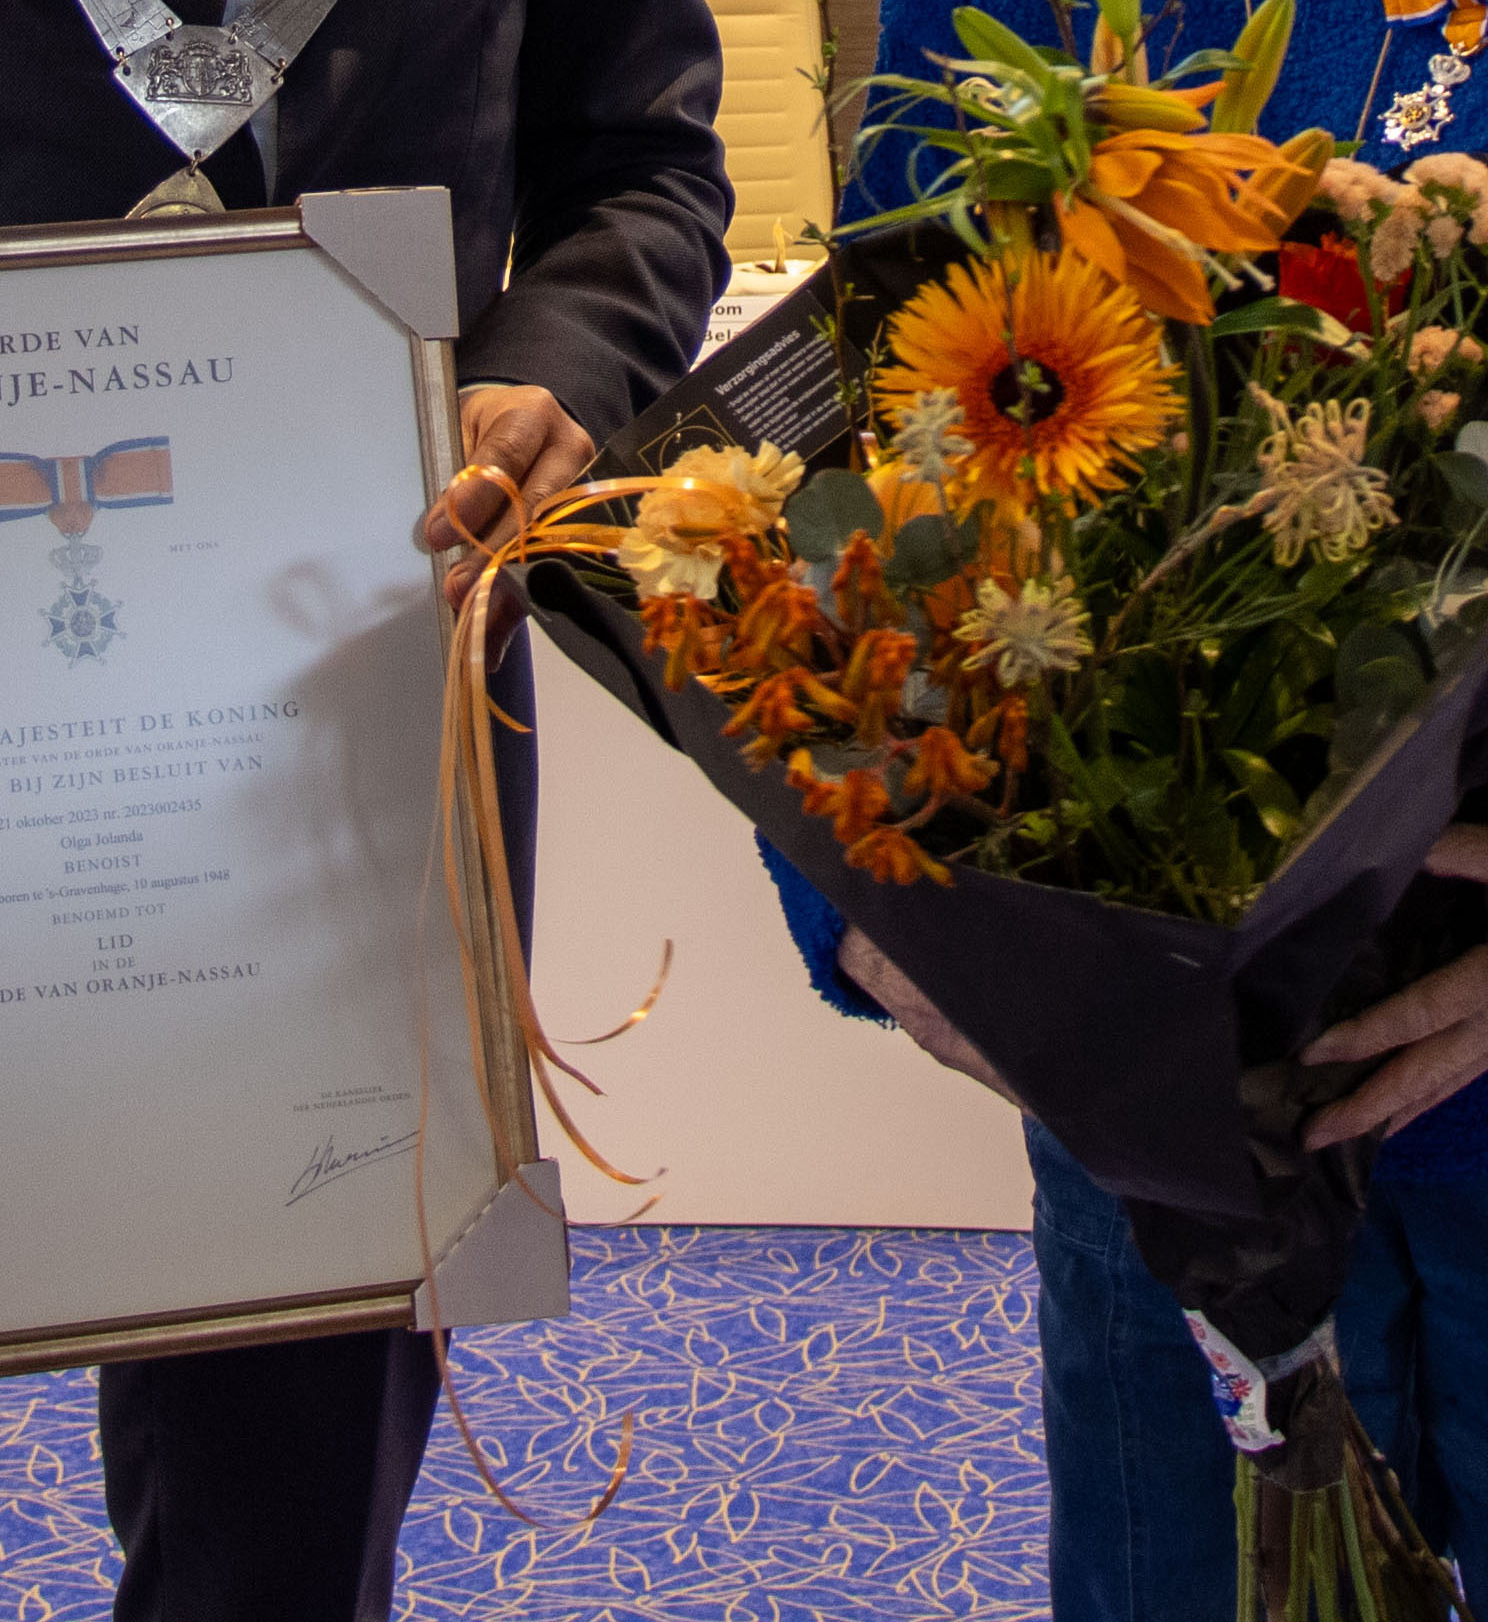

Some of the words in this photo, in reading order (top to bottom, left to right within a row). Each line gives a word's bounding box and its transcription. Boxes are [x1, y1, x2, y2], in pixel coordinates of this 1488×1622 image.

[711, 306, 742, 316] om
[75, 325, 141, 348] VAN
[714, 330, 801, 396] Verzorgingsadvies
[140, 713, 173, 731] DE
[186, 700, 299, 727] KONING
[32, 749, 59, 764] VAN
[64, 749, 80, 761] DE
[84, 746, 120, 760] ORDE
[126, 742, 153, 755] VAN
[10, 776, 43, 794] BIJ
[52, 770, 104, 790] ZIJN
[114, 760, 208, 783] BESLUIT
[217, 754, 263, 773] VAN
[16, 813, 65, 829] oktober
[67, 808, 99, 824] 2023
[103, 810, 121, 820] nr.
[60, 835, 92, 850] Olga
[96, 829, 144, 845] Jolanda
[64, 854, 141, 874] BENOIST
[32, 891, 43, 900] te
[151, 874, 200, 890] augustus
[203, 869, 231, 882] 1948
[52, 906, 130, 925] BENOEMD
[135, 902, 167, 917] TOT
[97, 933, 134, 951] LID
[92, 958, 110, 972] IN
[115, 956, 136, 969] DE
[35, 981, 79, 1000] VAN
[86, 962, 262, 994] ORANJE-NASSAU
